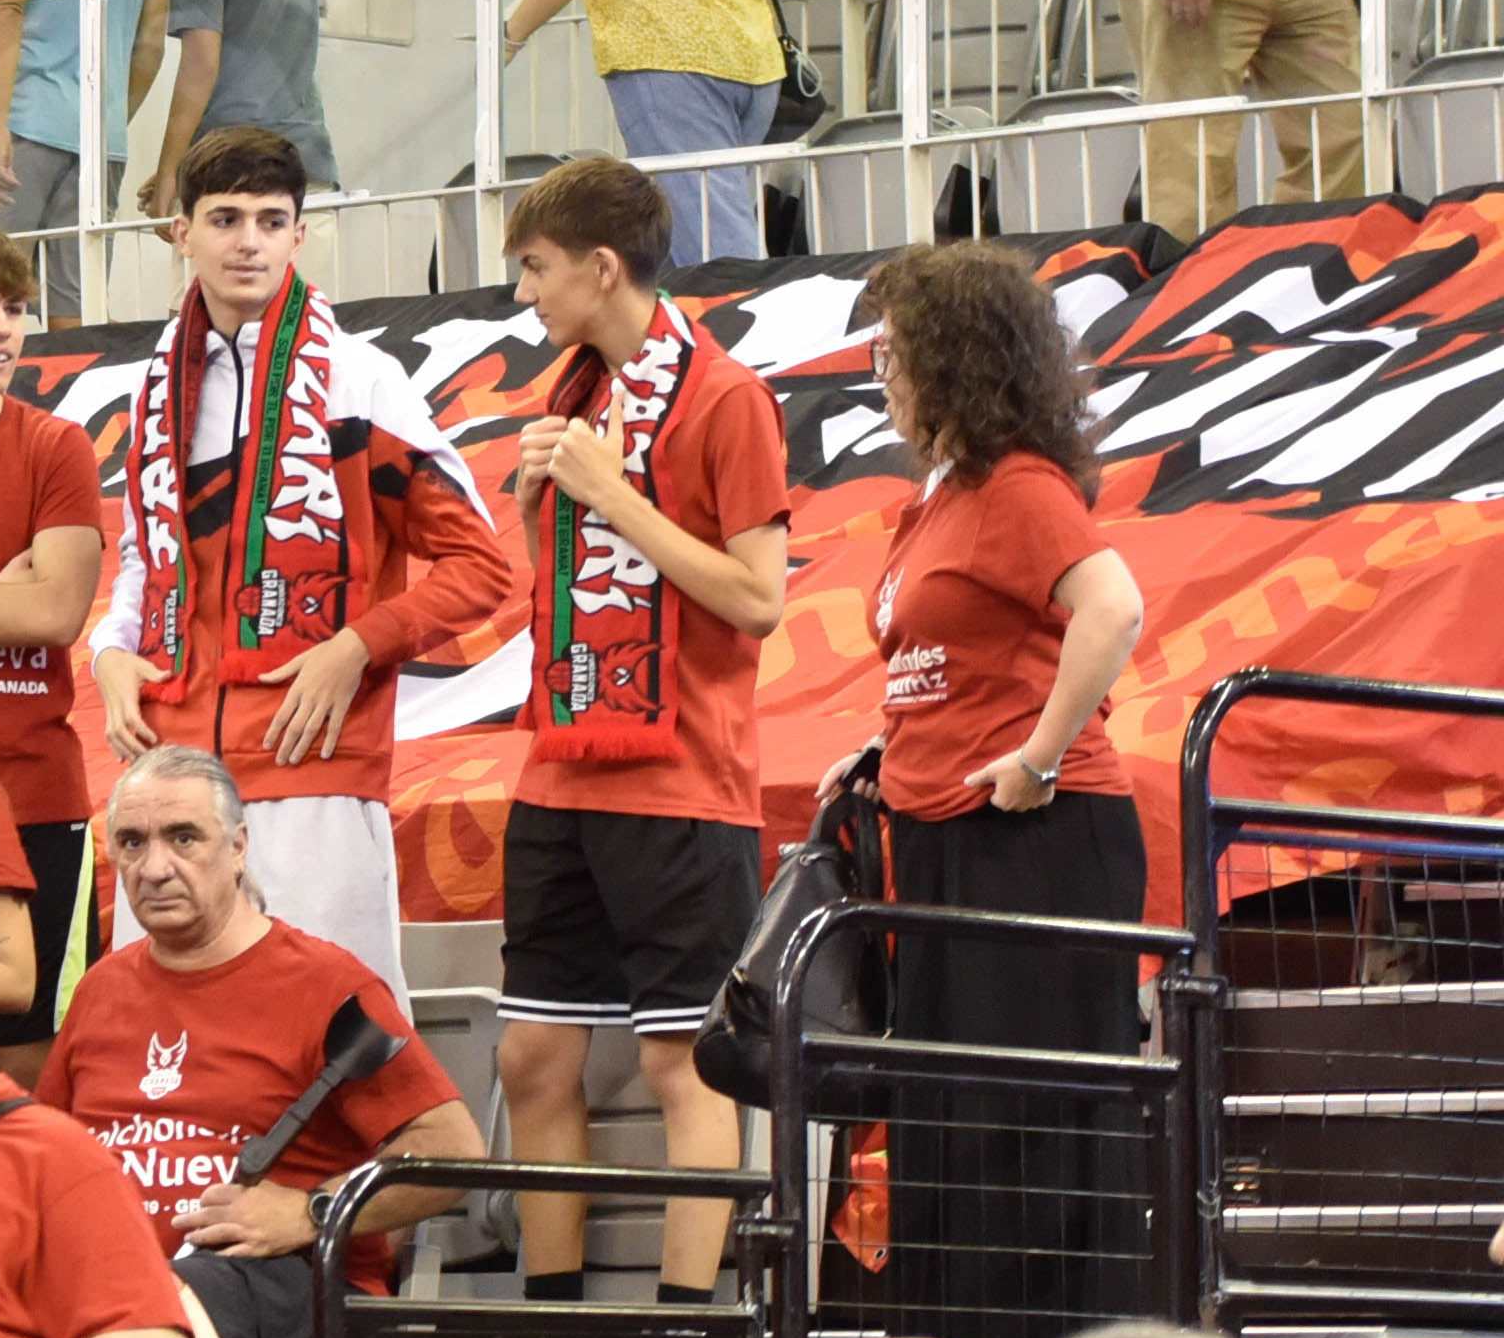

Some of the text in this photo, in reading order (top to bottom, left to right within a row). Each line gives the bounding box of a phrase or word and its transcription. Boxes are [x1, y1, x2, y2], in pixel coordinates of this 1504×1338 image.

[259, 569, 279, 636] GRANADA
[570, 643, 589, 712] GRANADA
[122, 1147, 242, 1189] Nuev
